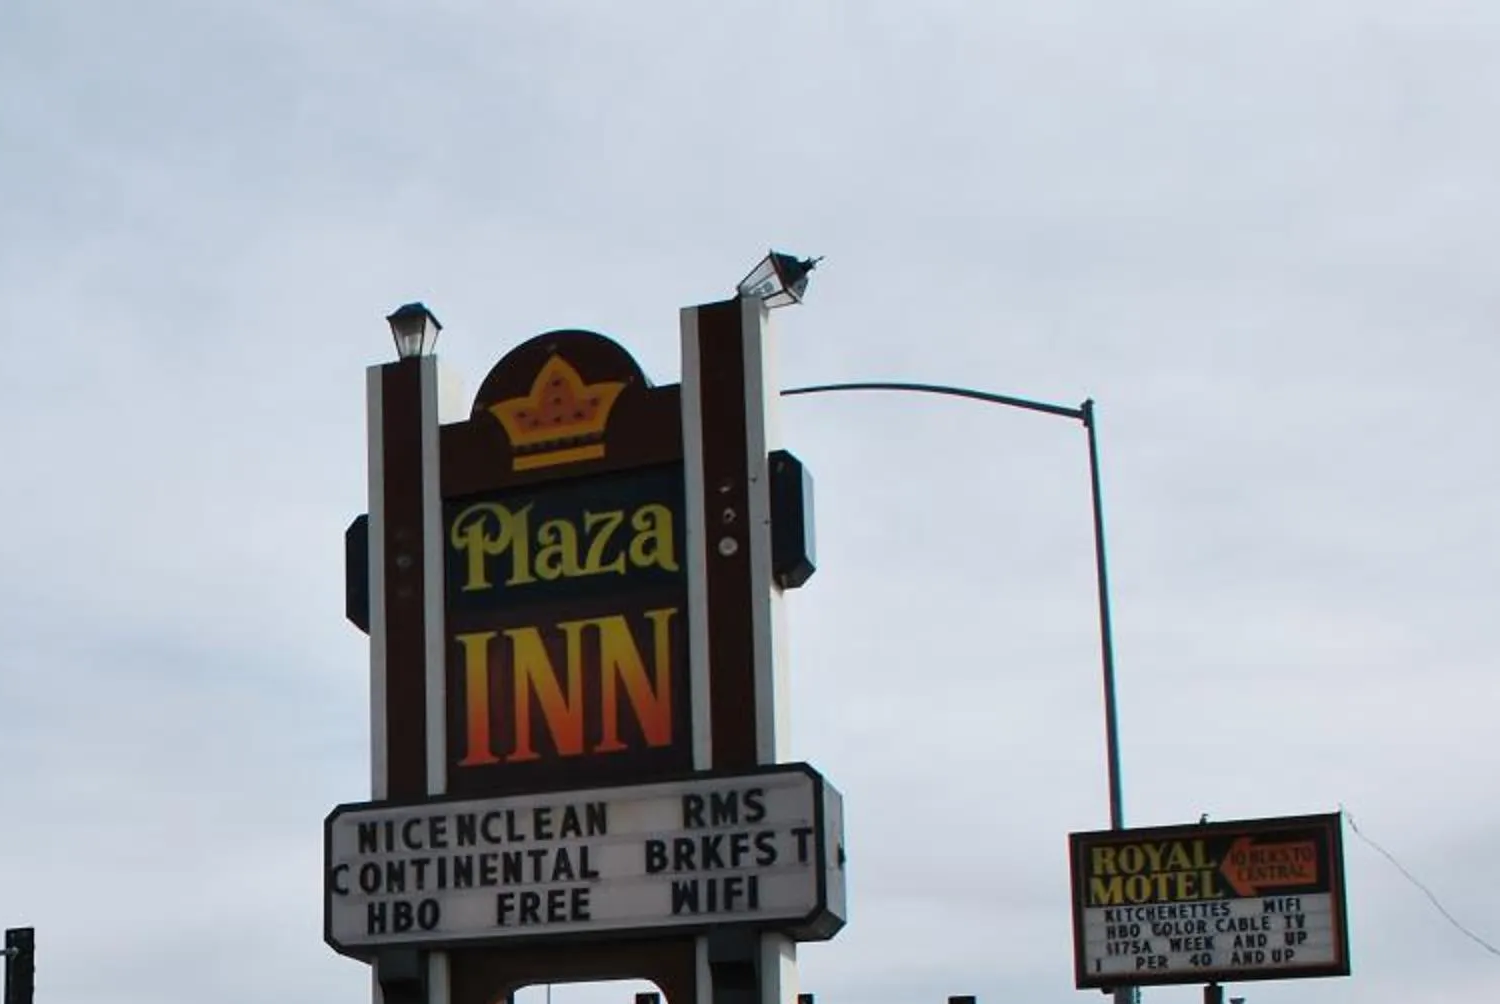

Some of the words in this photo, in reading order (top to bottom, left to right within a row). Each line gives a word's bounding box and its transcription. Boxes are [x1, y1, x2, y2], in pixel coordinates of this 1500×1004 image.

[451, 502, 679, 592] Plaza
[455, 607, 678, 767] INN
[358, 801, 607, 853] NICENCLEAN
[682, 788, 767, 829] RMS
[331, 845, 599, 896] CONTINENTAL
[645, 826, 813, 874] BRKFST
[1091, 839, 1217, 875] ROYAL
[367, 898, 441, 936] HBO
[496, 887, 591, 927] FREE
[671, 875, 759, 915] WIFI
[1089, 870, 1224, 905] MOTEL
[1104, 901, 1231, 923] KITCHENETTES
[1262, 898, 1301, 914] WIFI
[1106, 923, 1141, 939] HBO
[1151, 919, 1208, 938] COLOR
[1215, 916, 1271, 934] CABLE
[1284, 914, 1306, 929] TV
[1135, 954, 1169, 970] PER
[1230, 949, 1265, 965] AND
[1271, 948, 1295, 963] UP
[1169, 936, 1215, 953] WEEK
[1233, 933, 1268, 949] AND
[1283, 931, 1308, 946] UP
